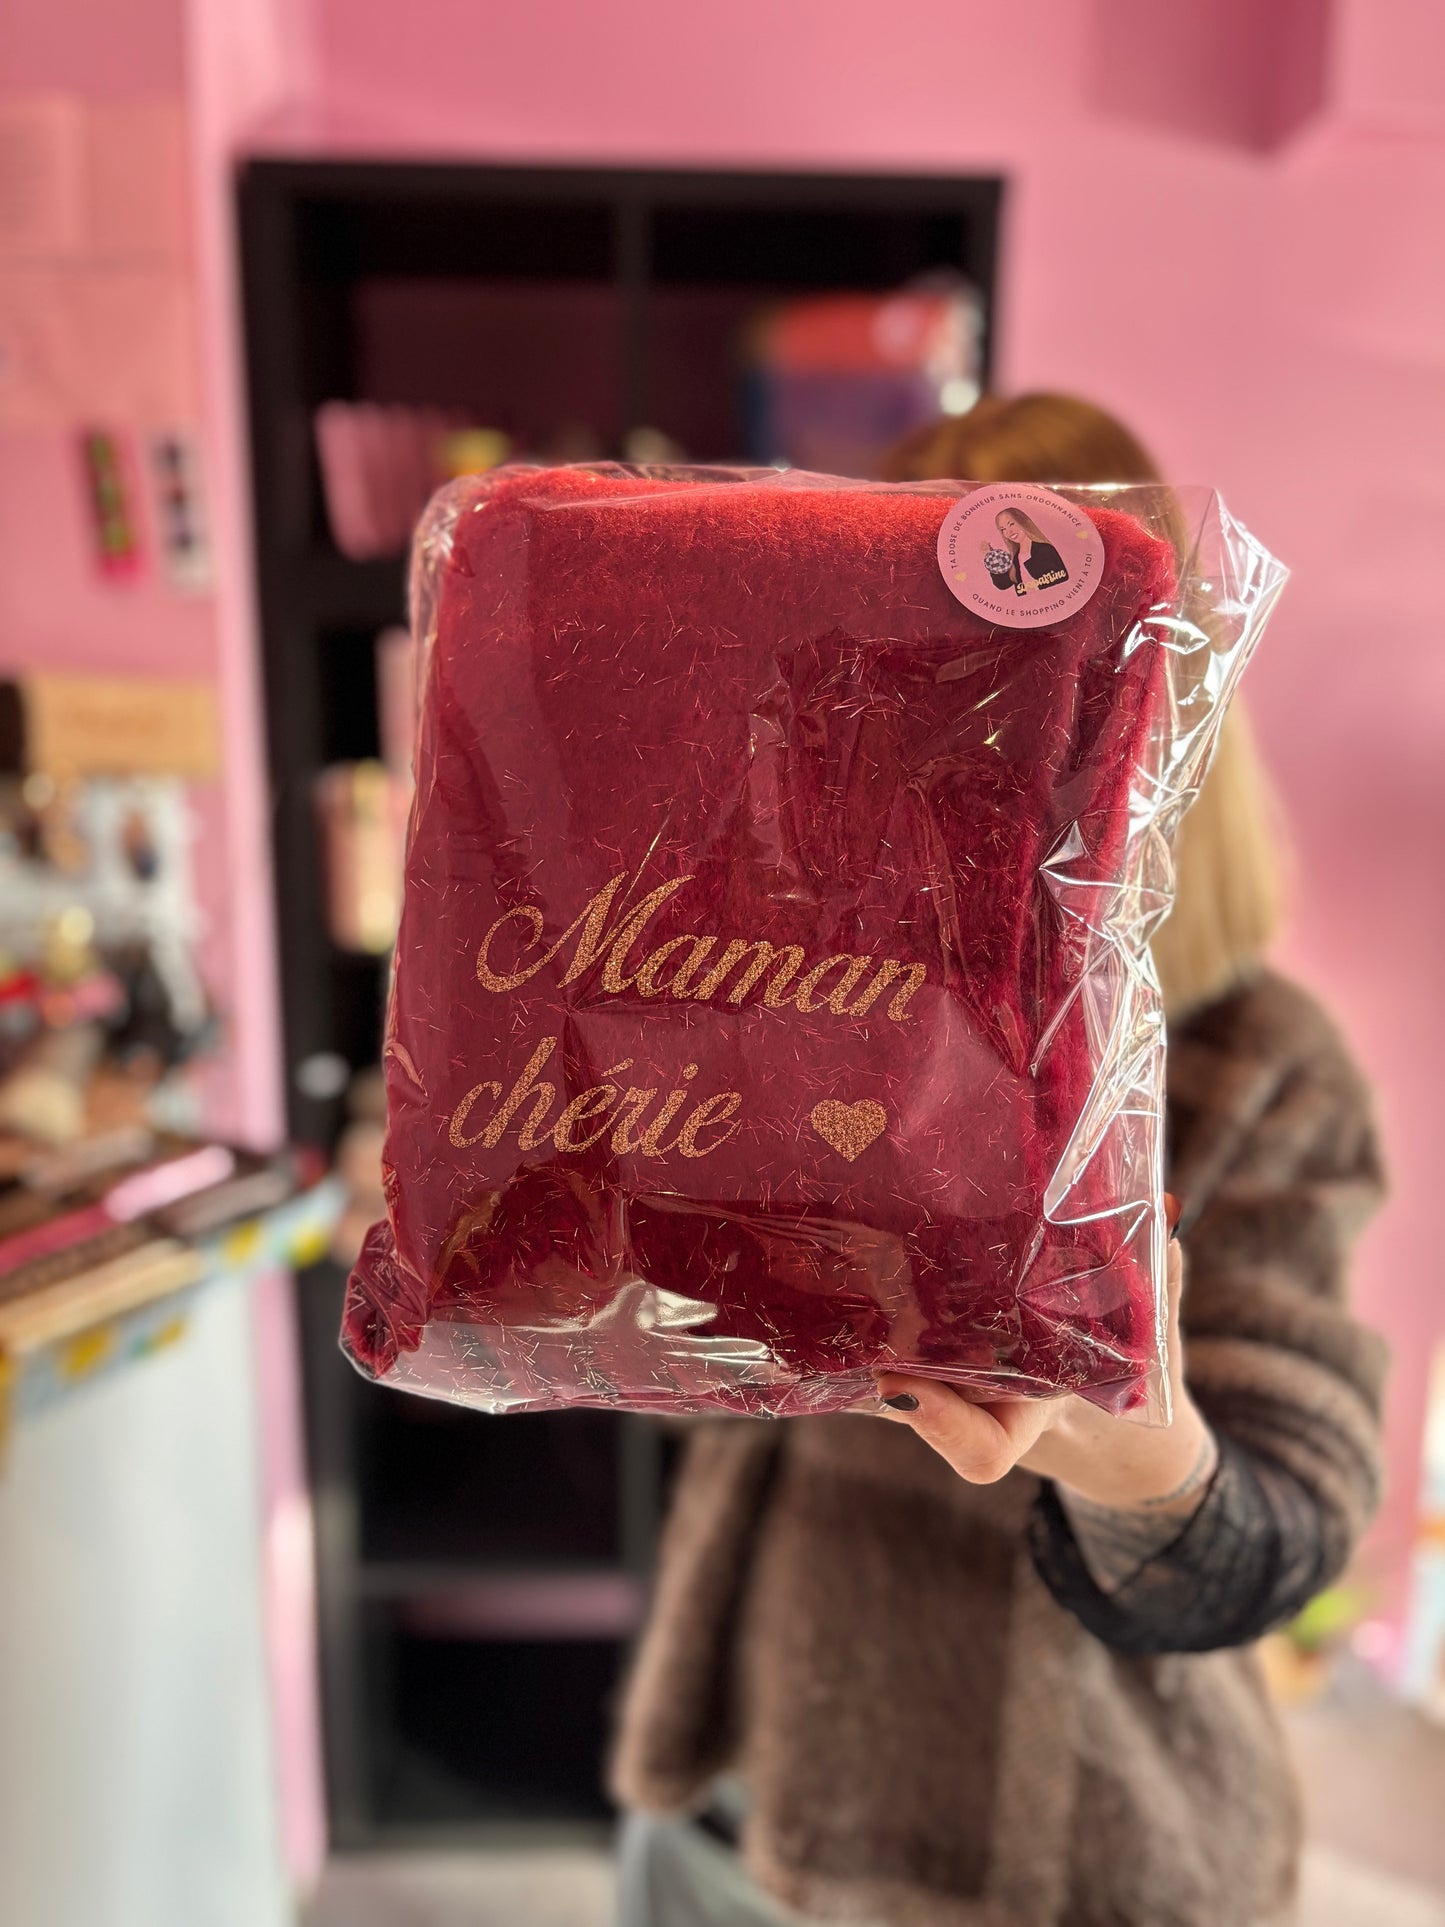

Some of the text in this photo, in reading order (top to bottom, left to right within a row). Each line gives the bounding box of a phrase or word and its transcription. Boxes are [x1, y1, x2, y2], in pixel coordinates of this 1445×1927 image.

[961, 496, 995, 520] BONHEUR
[1026, 494, 1082, 528] ORDONNANCE
[954, 521, 962, 532] DE
[949, 534, 957, 555] DOSE
[951, 558, 958, 569] TA
[972, 593, 1002, 613] QUAND
[1020, 599, 1065, 617] SHOPPING
[1065, 579, 1085, 599] VIENT
[1085, 553, 1093, 568] TOI
[476, 870, 926, 1021] Maman
[449, 1036, 743, 1158] chérie
